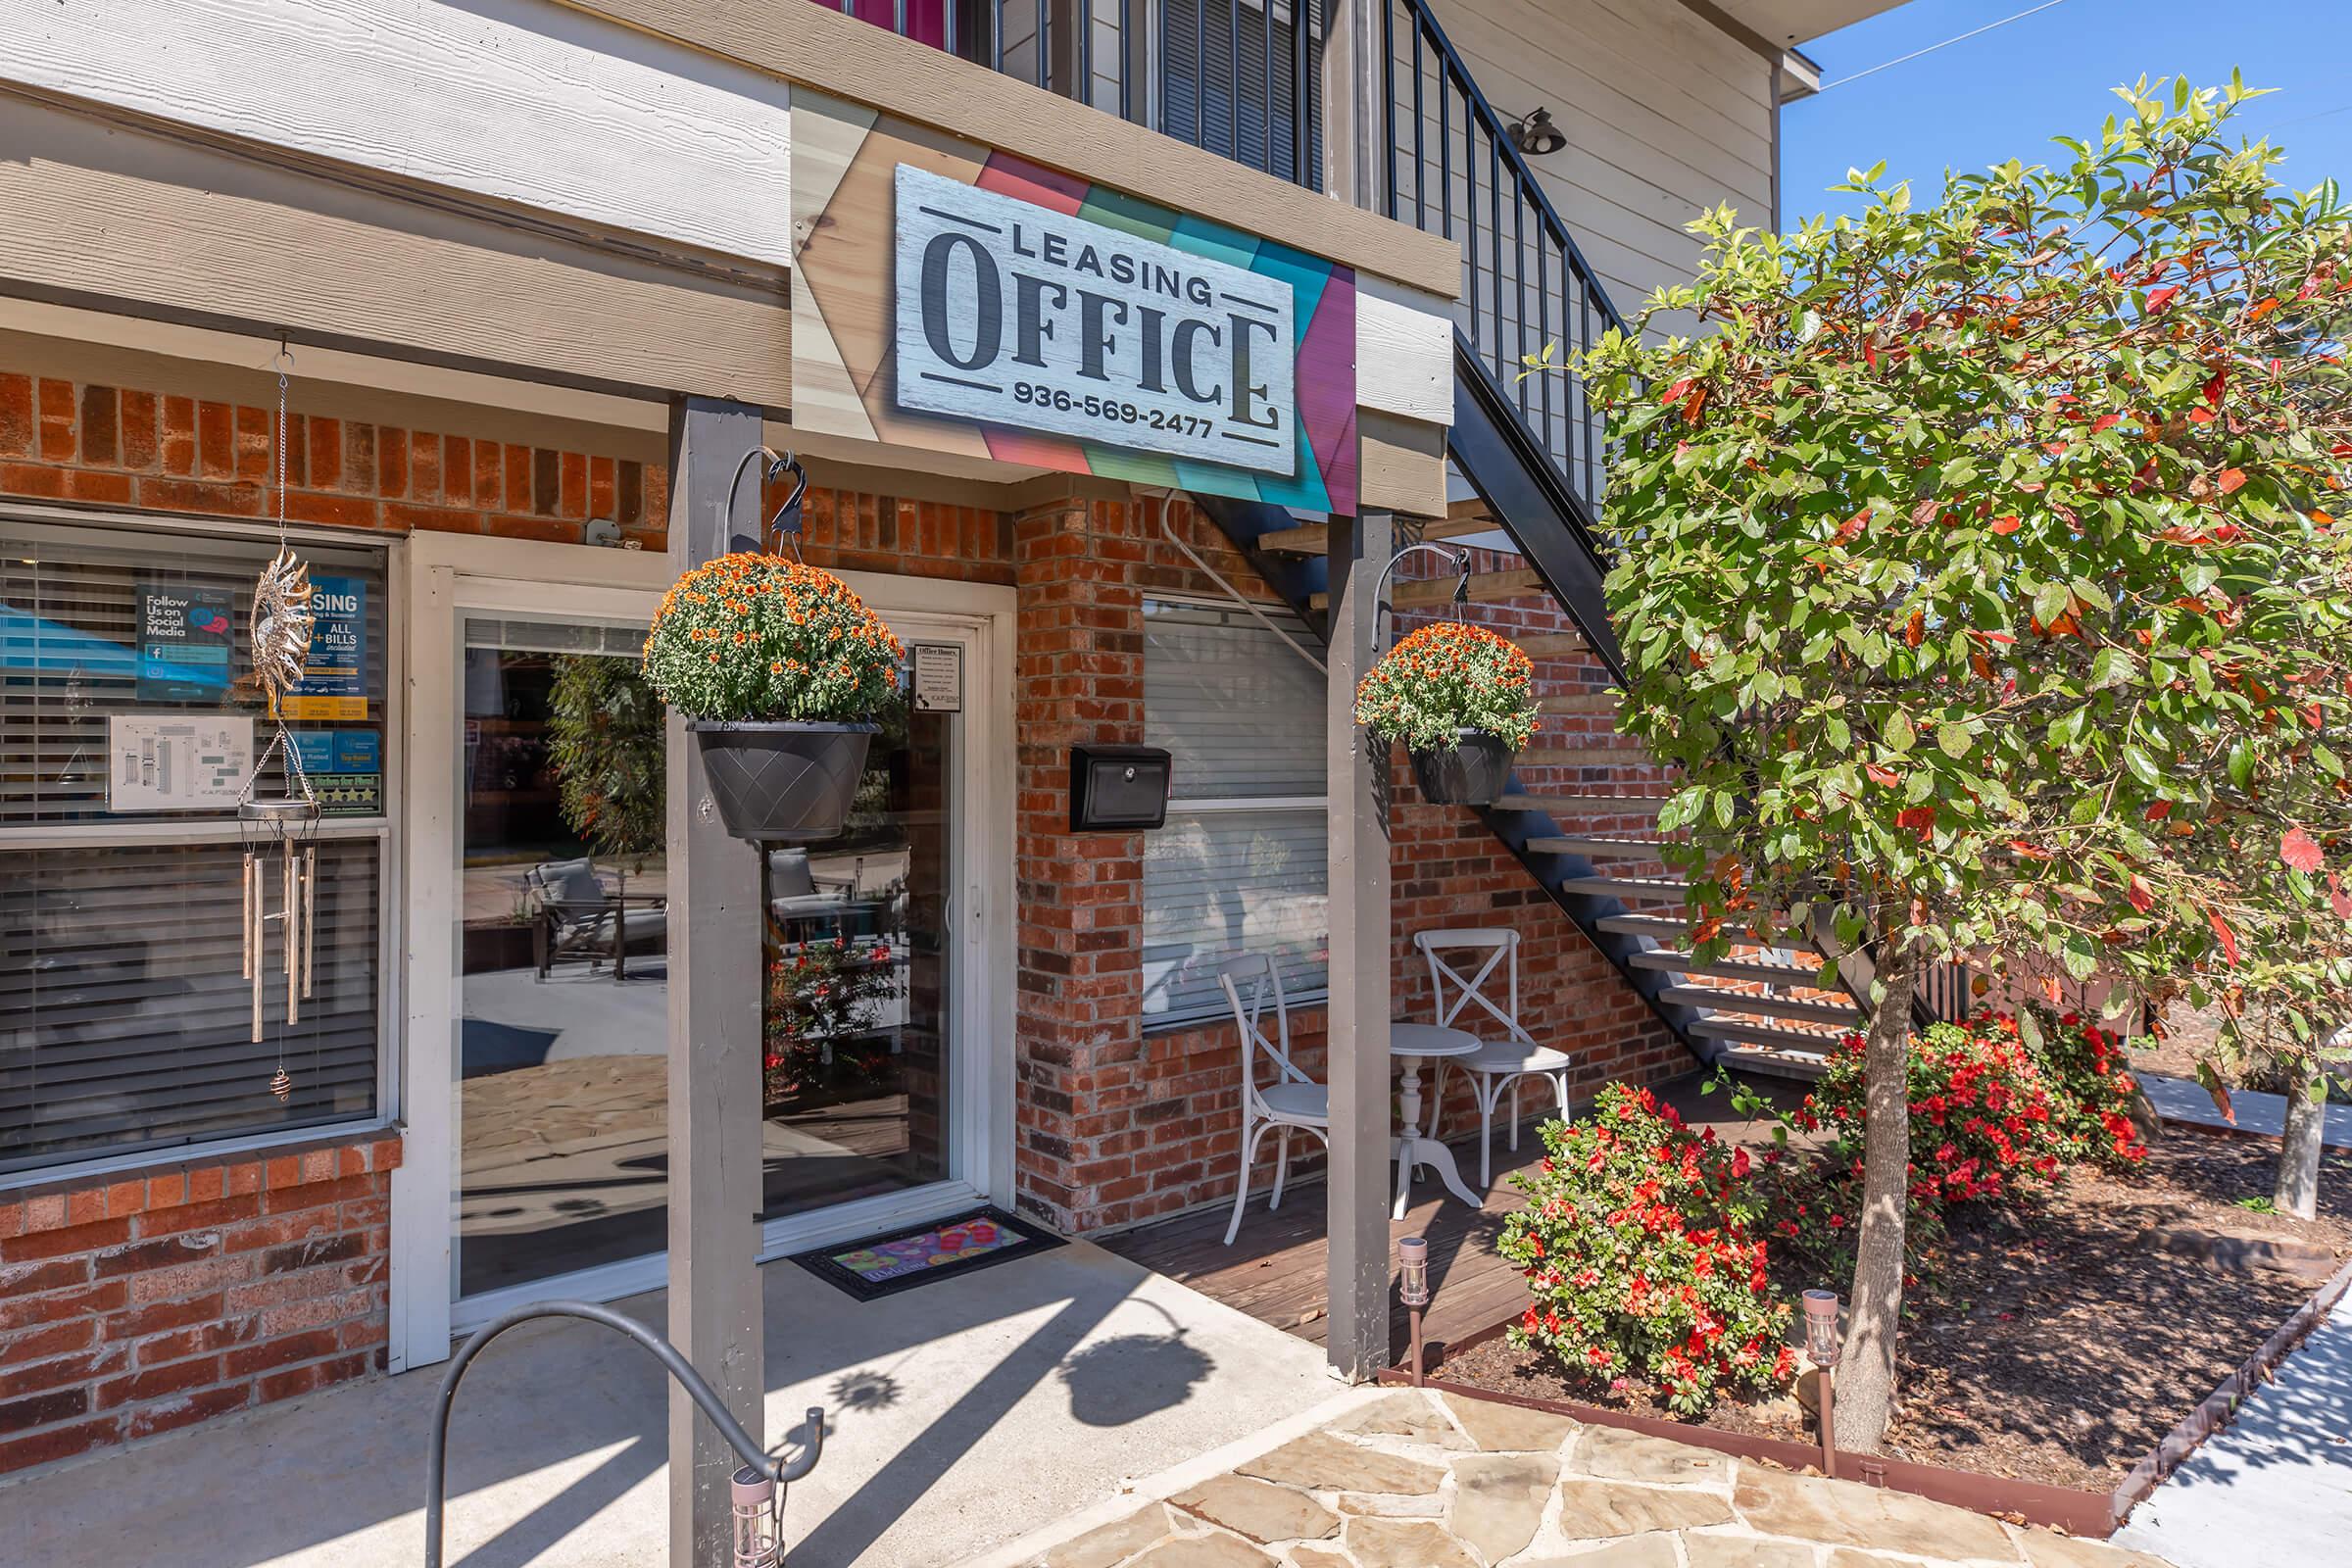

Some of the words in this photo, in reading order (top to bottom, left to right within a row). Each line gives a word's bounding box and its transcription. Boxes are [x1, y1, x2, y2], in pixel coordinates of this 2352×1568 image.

[1013, 223, 1211, 307] LEASING
[921, 232, 1278, 429] OFFICE
[1014, 382, 1213, 438] 936-569-2477
[147, 595, 188, 607] Follow
[147, 606, 163, 615] Us
[147, 616, 183, 626] Social
[146, 626, 185, 636] Media
[330, 623, 352, 634] ALL
[325, 634, 357, 644] BILLS
[867, 1261, 927, 1282] Welcome
